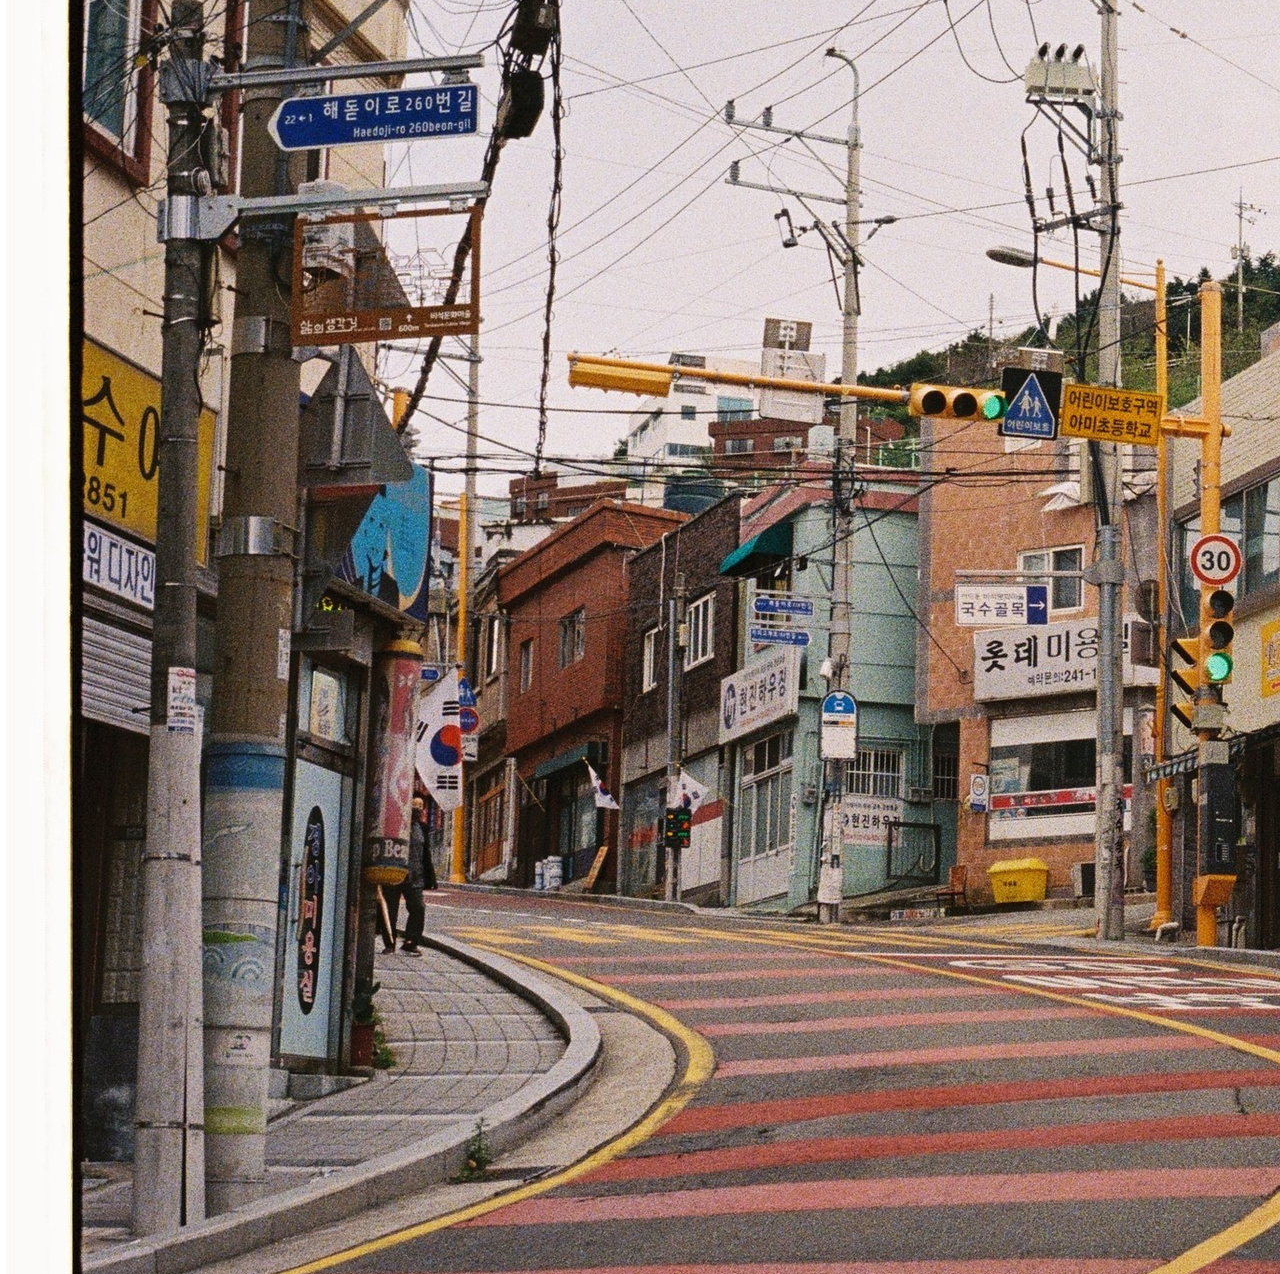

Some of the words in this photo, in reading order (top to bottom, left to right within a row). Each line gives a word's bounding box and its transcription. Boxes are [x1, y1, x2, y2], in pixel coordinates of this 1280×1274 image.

[285, 115, 296, 125] 22
[353, 124, 406, 138] Haedoji-ro
[409, 119, 471, 134] 260beon-gil
[398, 324, 420, 333] 600m
[1007, 419, 1050, 432] 어린이보호
[1070, 414, 1152, 439] 아미초등학교
[83, 475, 129, 519] 851
[1200, 550, 1231, 571] 30
[961, 602, 1024, 617] 국수골목
[981, 635, 1039, 673] 롯데
